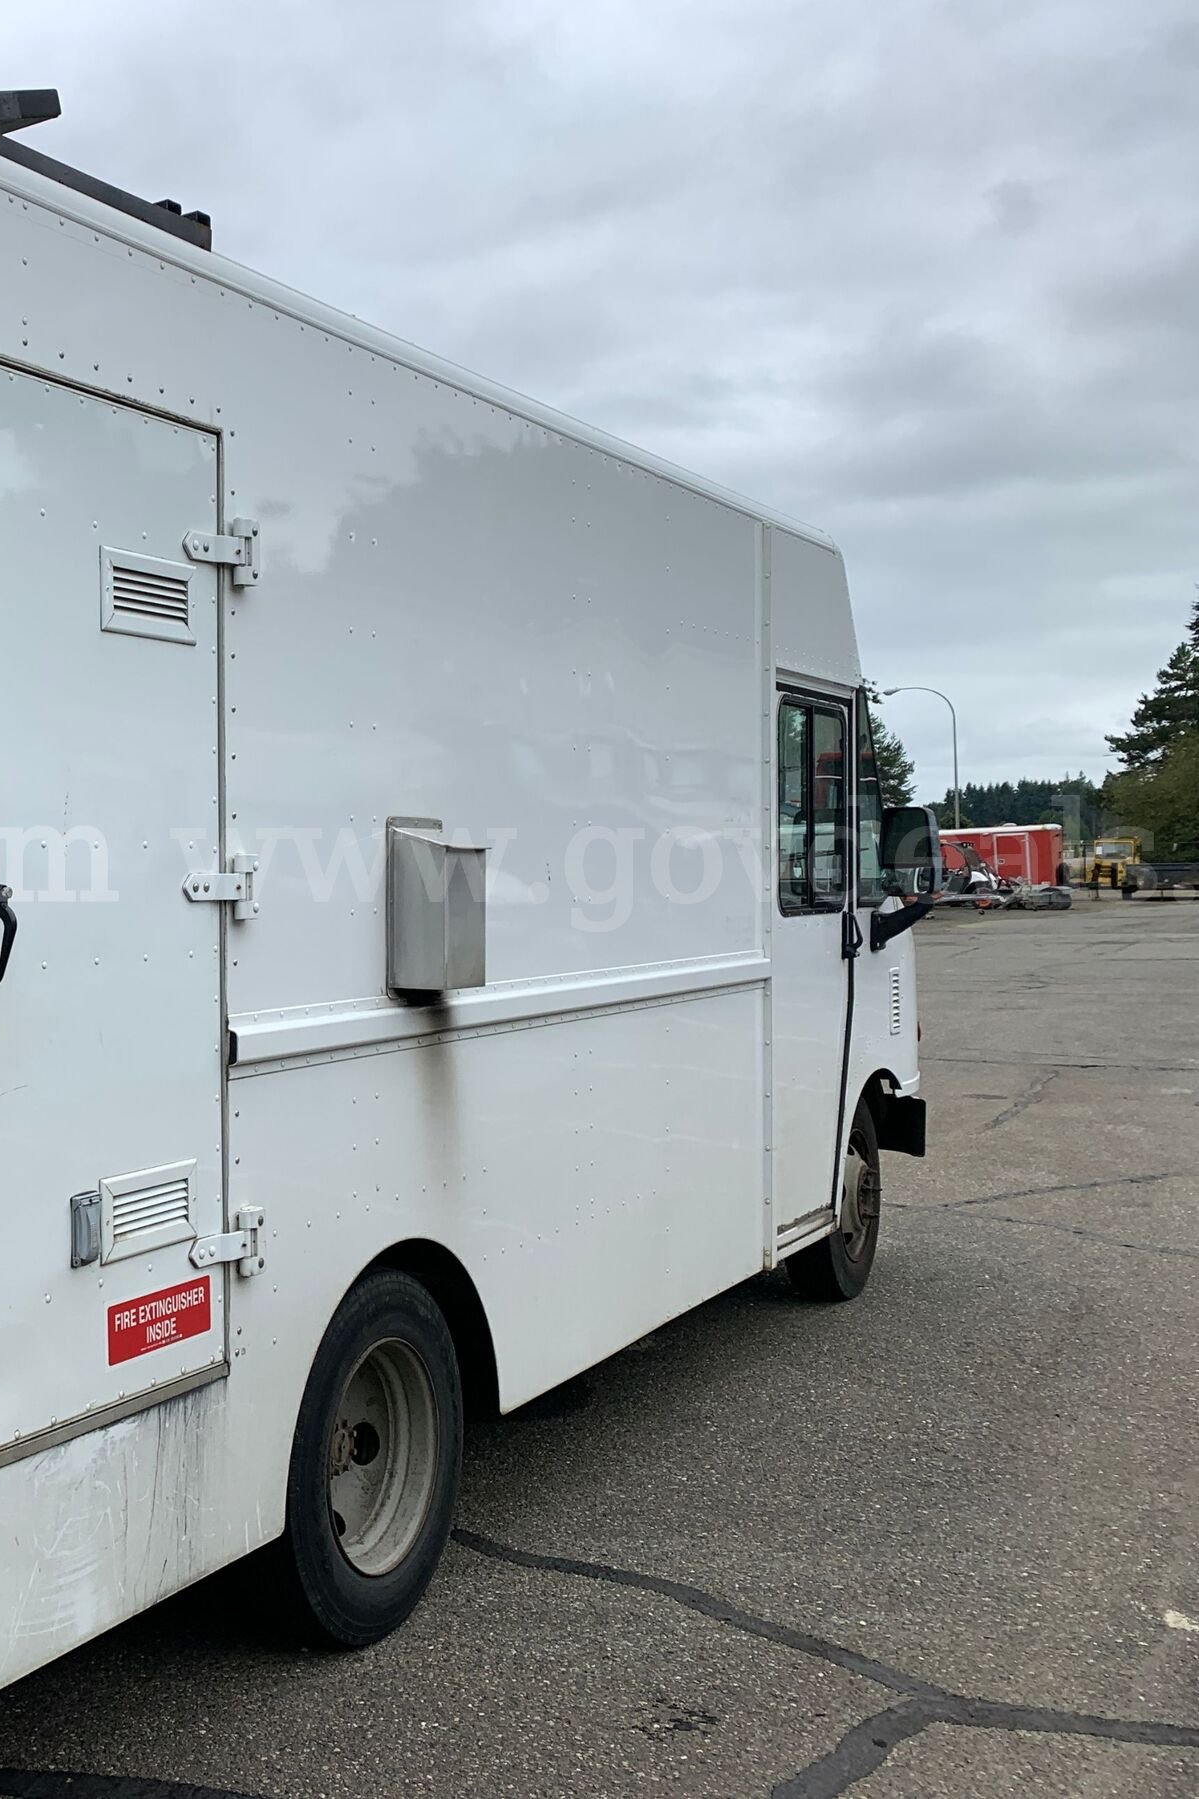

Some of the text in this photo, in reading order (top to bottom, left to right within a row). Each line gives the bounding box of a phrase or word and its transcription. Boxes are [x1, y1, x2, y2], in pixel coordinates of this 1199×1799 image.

[114, 1286, 205, 1332] FIRE EXTINGUISHER
[146, 1317, 177, 1344] INSIDE
